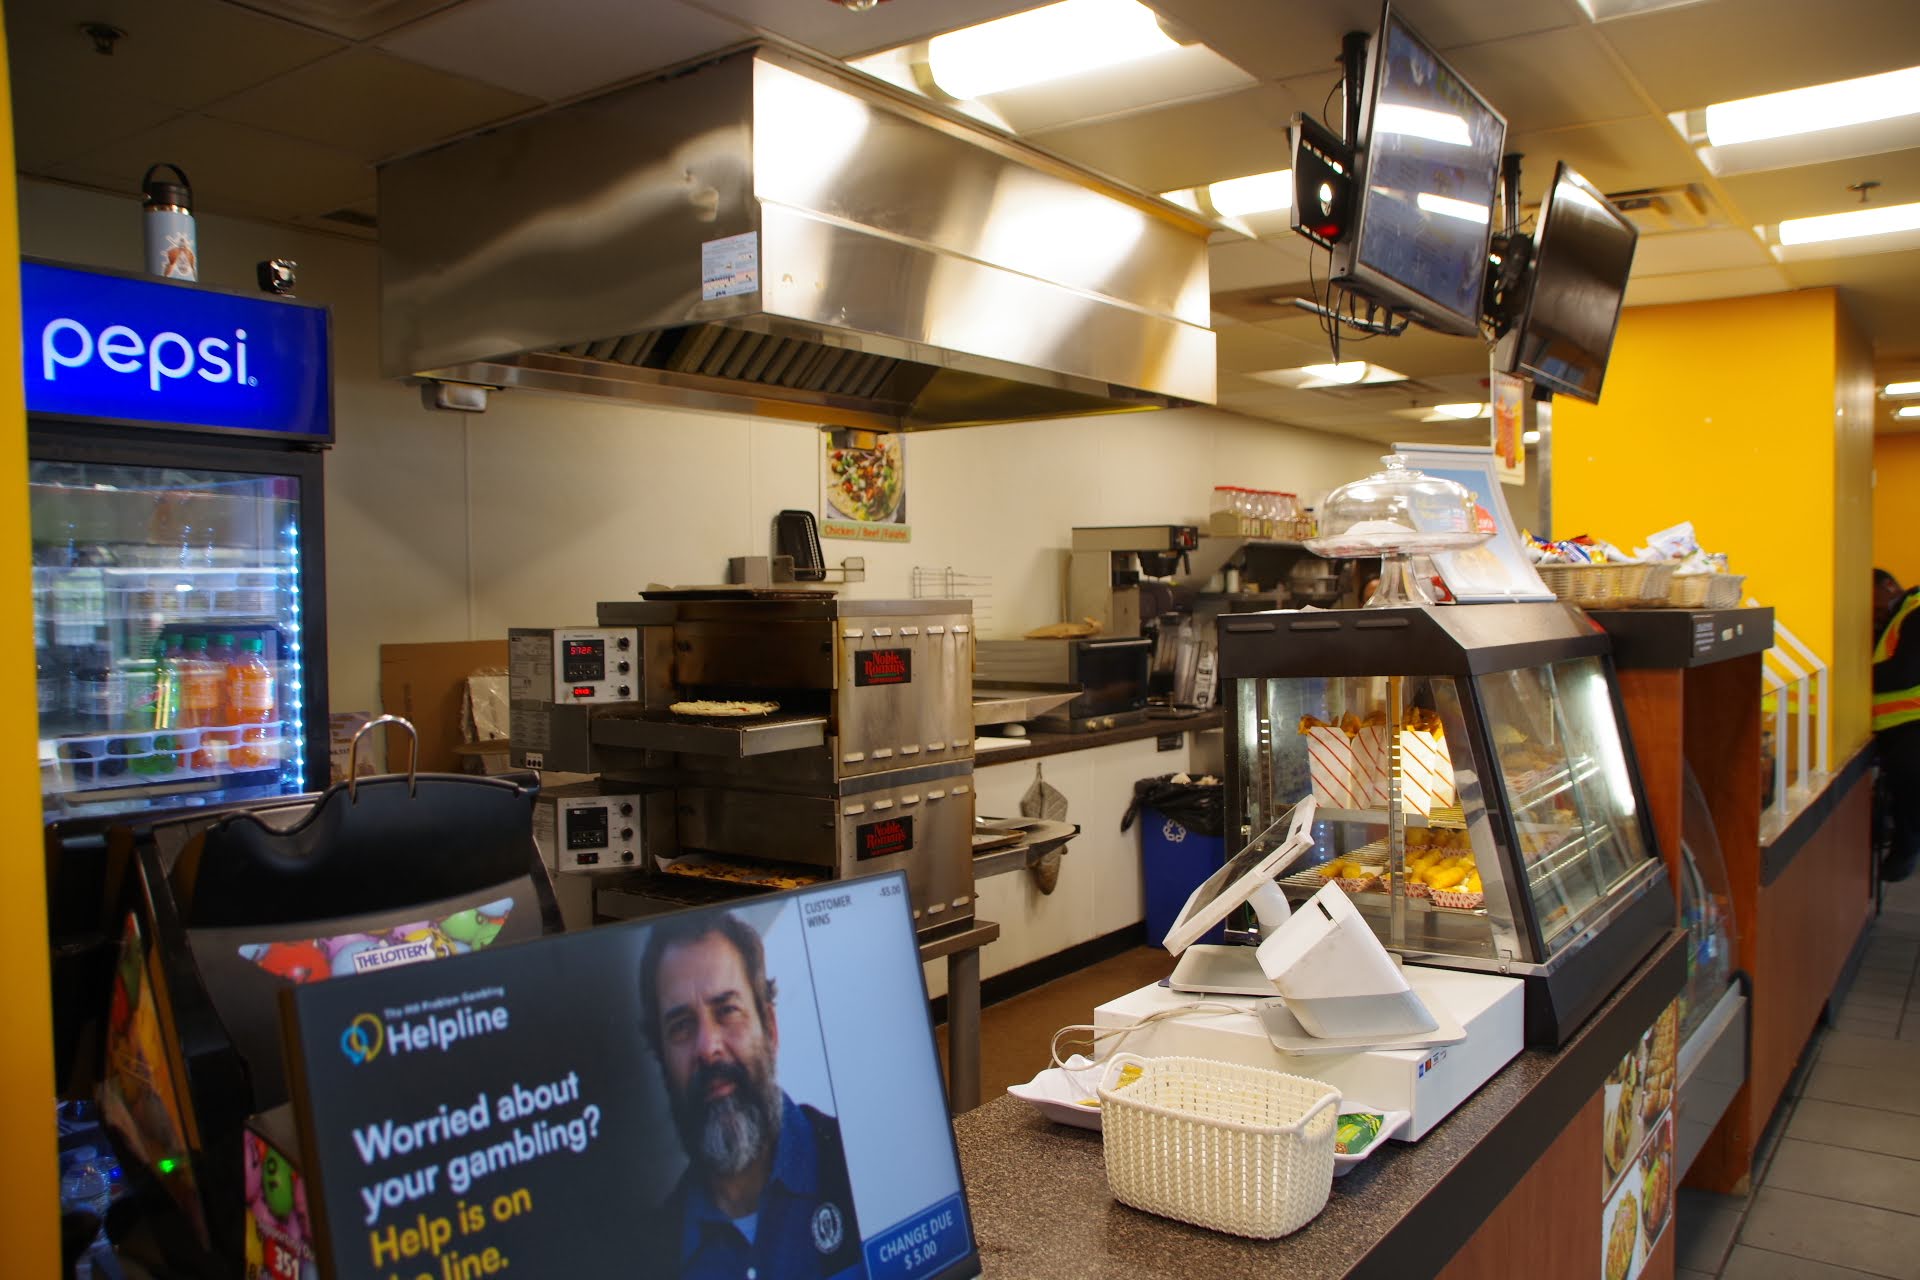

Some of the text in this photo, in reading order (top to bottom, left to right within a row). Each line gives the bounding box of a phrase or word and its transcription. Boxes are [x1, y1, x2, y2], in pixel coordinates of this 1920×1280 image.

[42, 317, 247, 392] pepsi
[872, 650, 899, 665] Noble
[874, 821, 901, 837] Noble
[804, 895, 852, 914] CUSTOMER
[806, 913, 831, 928] WINS
[356, 943, 428, 968] THE LOTTERY
[386, 1005, 509, 1056] Helpline
[353, 1070, 579, 1164] Worried about
[361, 1104, 600, 1225] your gambling?
[370, 1188, 533, 1268] Help is on
[880, 1210, 953, 1263] CHANGE DUE
[441, 1247, 509, 1280] line.
[913, 1240, 937, 1266] 5.00
